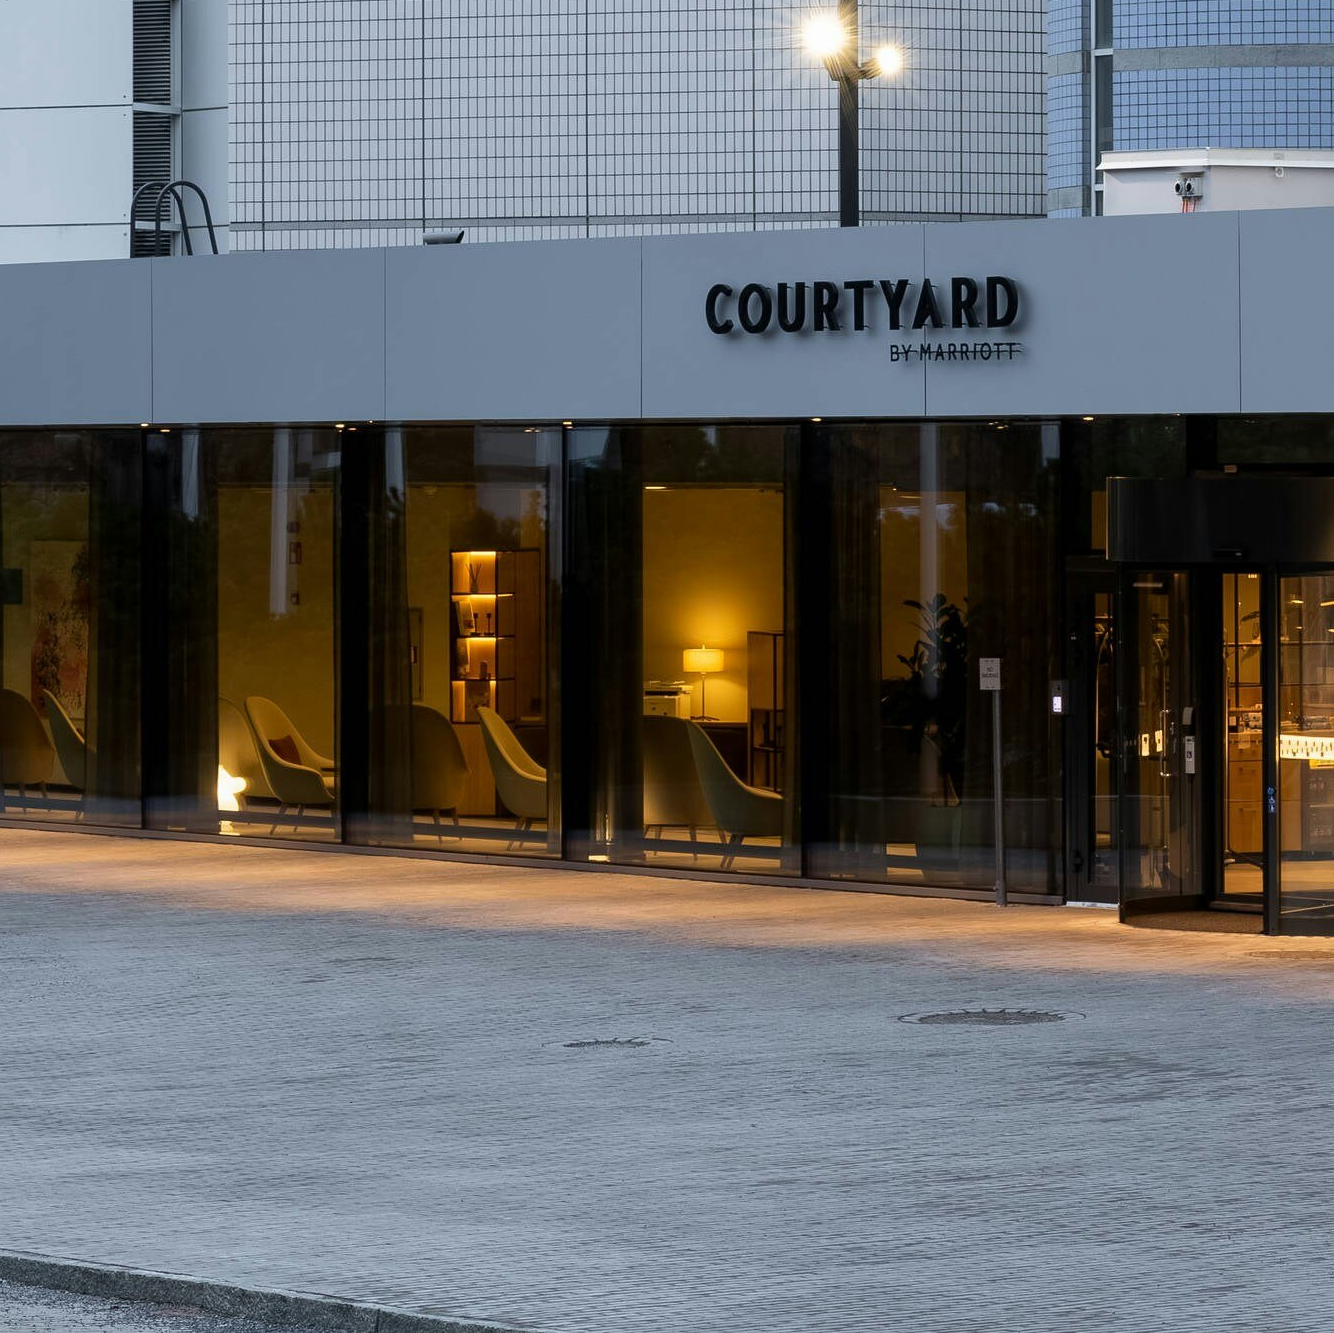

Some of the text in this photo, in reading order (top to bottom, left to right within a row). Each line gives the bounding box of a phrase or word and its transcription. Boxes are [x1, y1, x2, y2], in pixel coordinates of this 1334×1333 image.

[705, 276, 1019, 335] COURTYARD
[890, 342, 1017, 362] BY MARRIOTT
